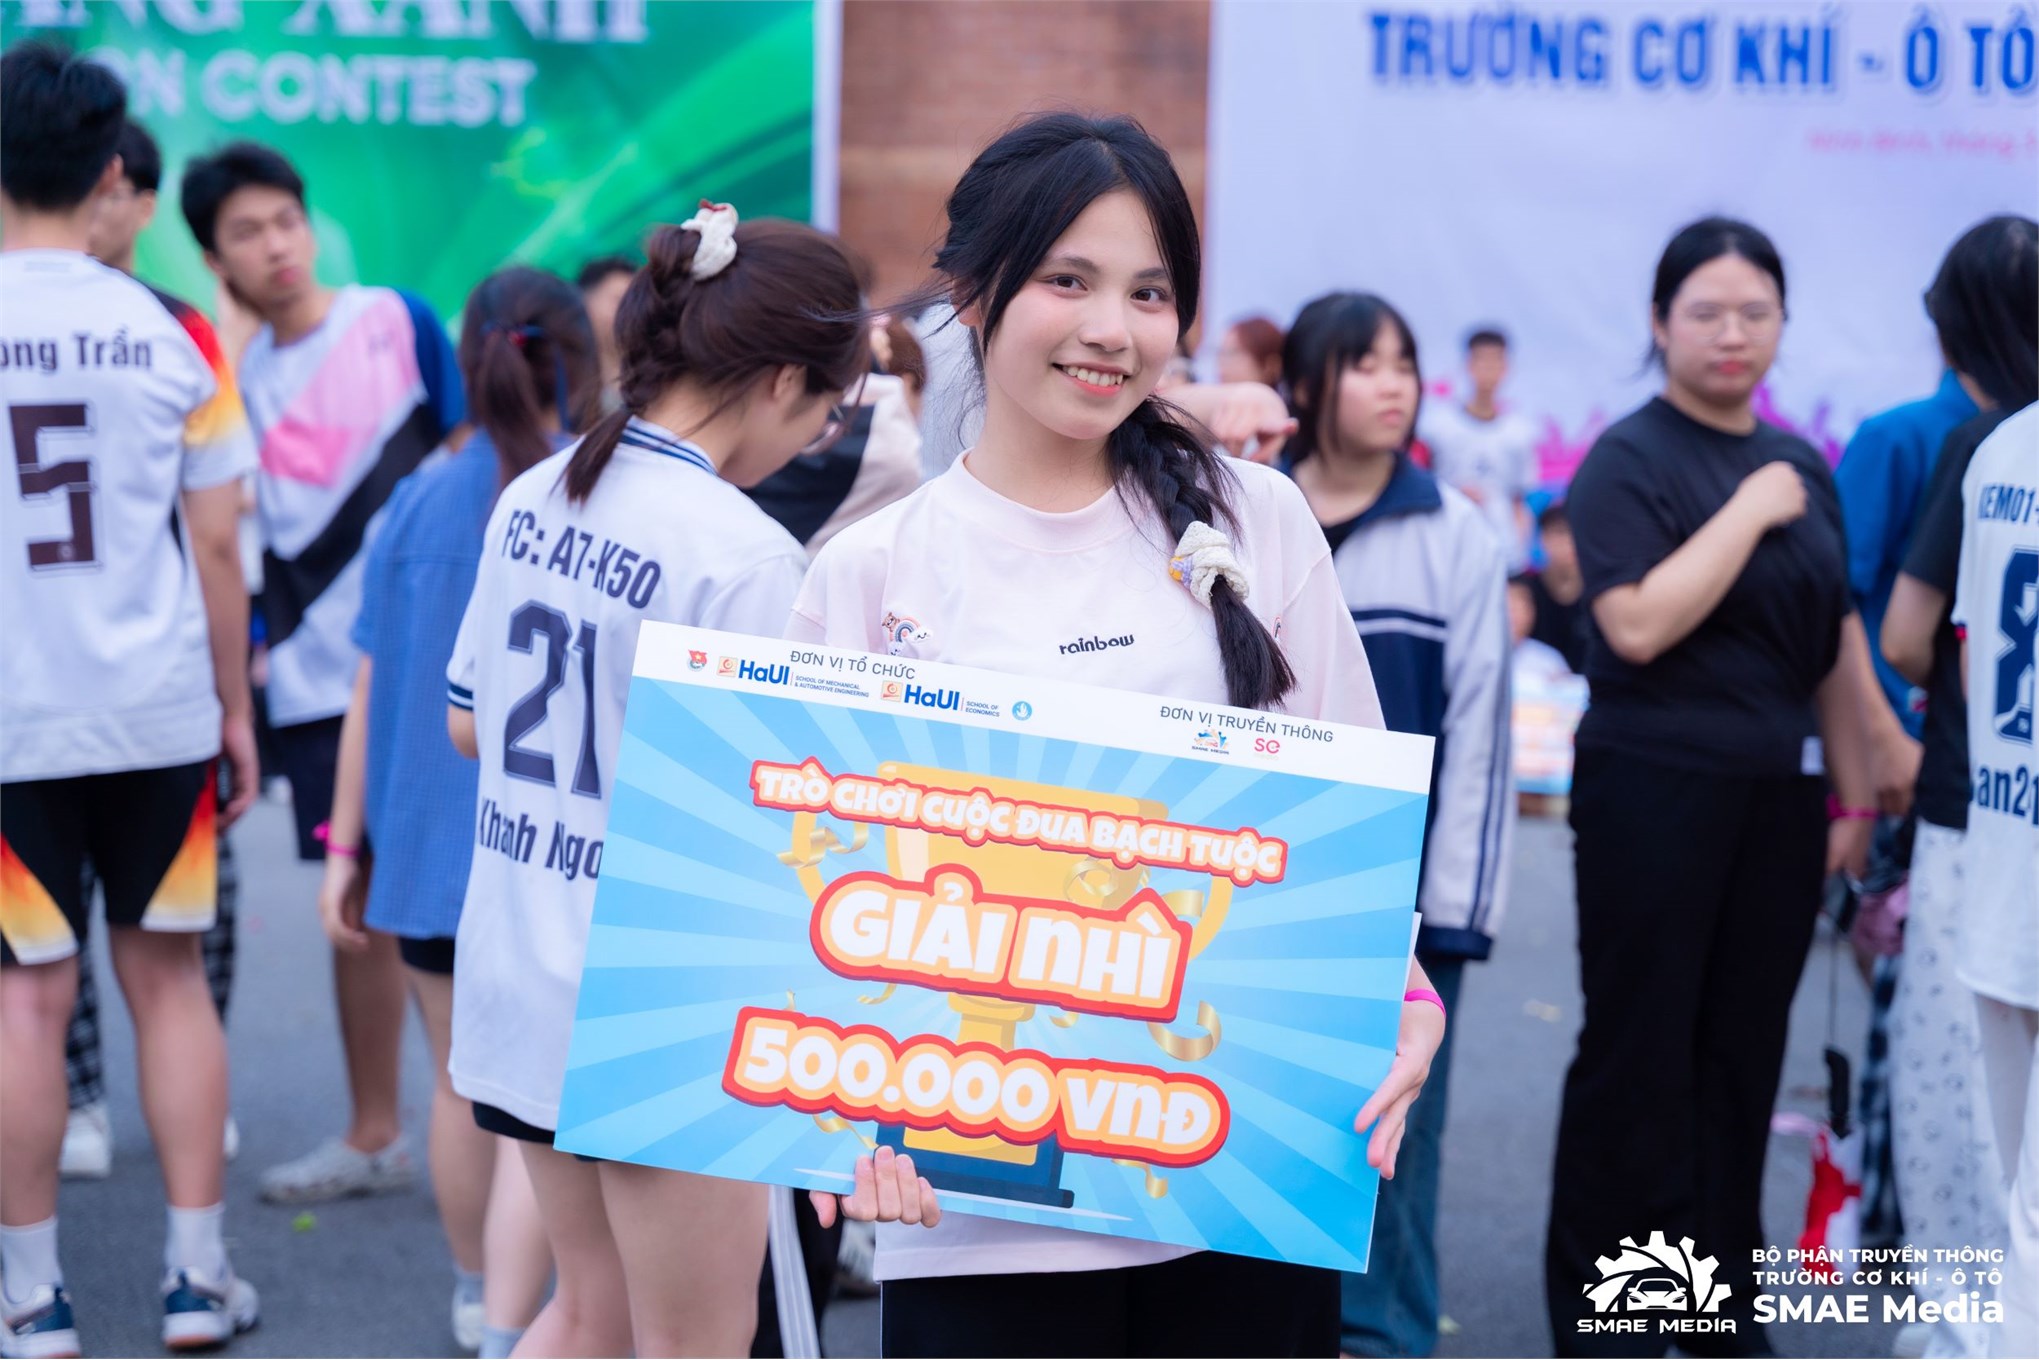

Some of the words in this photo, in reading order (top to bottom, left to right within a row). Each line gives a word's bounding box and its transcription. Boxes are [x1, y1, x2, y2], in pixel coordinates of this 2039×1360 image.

[203, 48, 538, 127] CONTEST
[10, 402, 99, 570] 5
[502, 509, 545, 566] FC:
[547, 525, 661, 610] A7-K50
[738, 659, 790, 686] HaUI
[790, 650, 824, 666] ĐƠN
[829, 655, 844, 672] VỊ
[848, 656, 868, 673] TỔ
[872, 663, 916, 680] CHỨC
[1059, 634, 1135, 655] rainbow
[503, 598, 602, 799] 21
[904, 684, 960, 711] HaUI
[1160, 705, 1194, 722] ĐƠN
[1198, 711, 1213, 728] VỊ
[1217, 714, 1277, 735] TRUYỀN
[1281, 722, 1334, 743] THÔNG
[760, 768, 829, 803] TRÒ
[834, 783, 917, 818] CHƠI
[922, 794, 1012, 838] CUỘC
[1016, 809, 1086, 843] ĐUA
[1092, 820, 1183, 859] BẠCH
[1190, 834, 1278, 877] TUỘC
[1970, 765, 2039, 826] an21
[830, 881, 1008, 974] GIẢI
[746, 1027, 1051, 1123] 500.000
